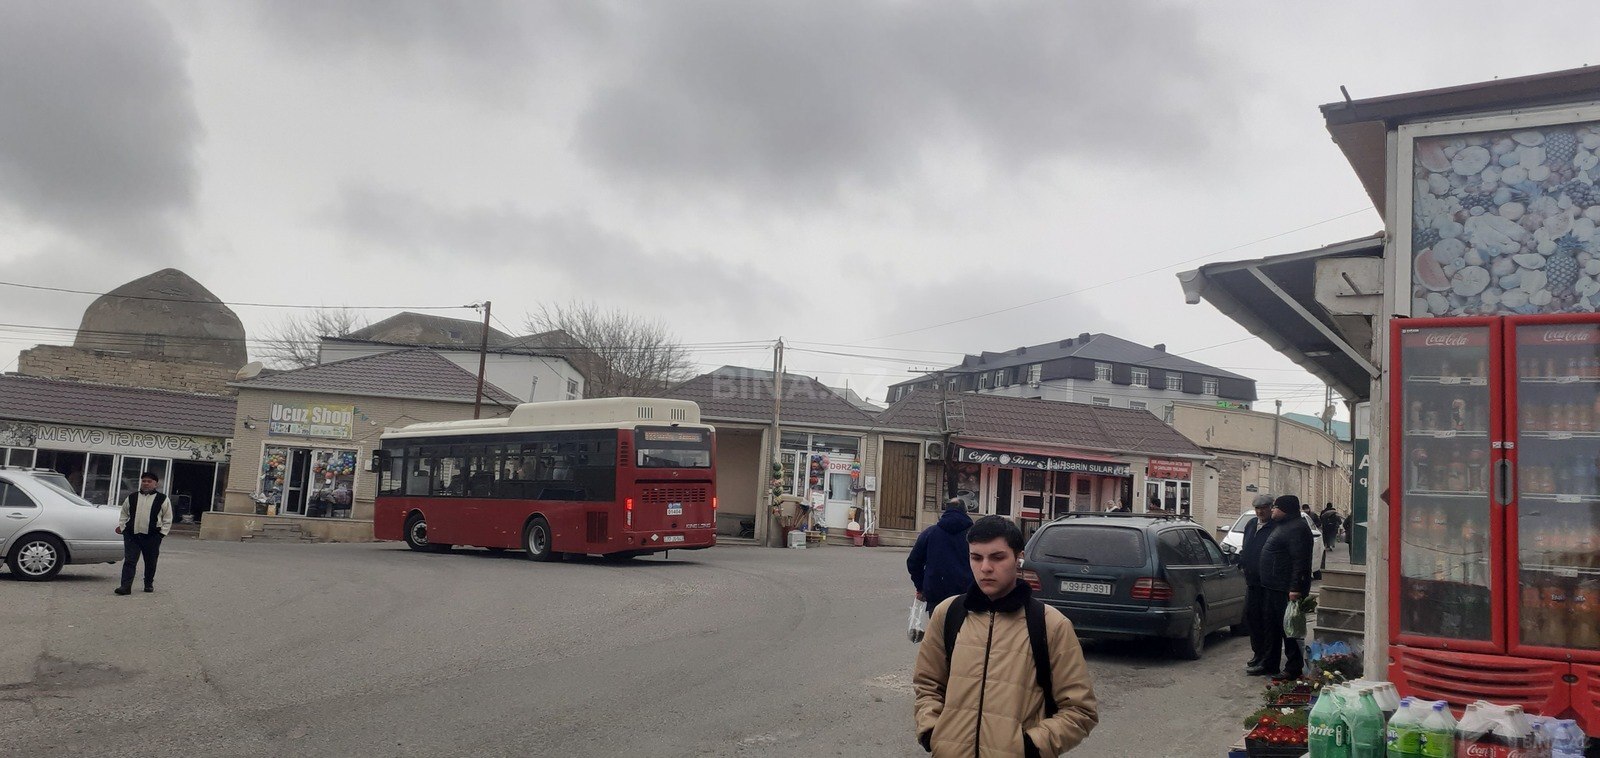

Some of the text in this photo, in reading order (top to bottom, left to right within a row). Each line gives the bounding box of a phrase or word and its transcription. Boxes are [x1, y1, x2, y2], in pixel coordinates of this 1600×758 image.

[271, 404, 352, 426] Ucuz Shop
[37, 425, 193, 451] MEYVƏ TƏRƏVƏZ
[968, 451, 1037, 466] Coffee Time
[830, 462, 852, 471] DƏRZ
[1089, 465, 1113, 474] SULAR
